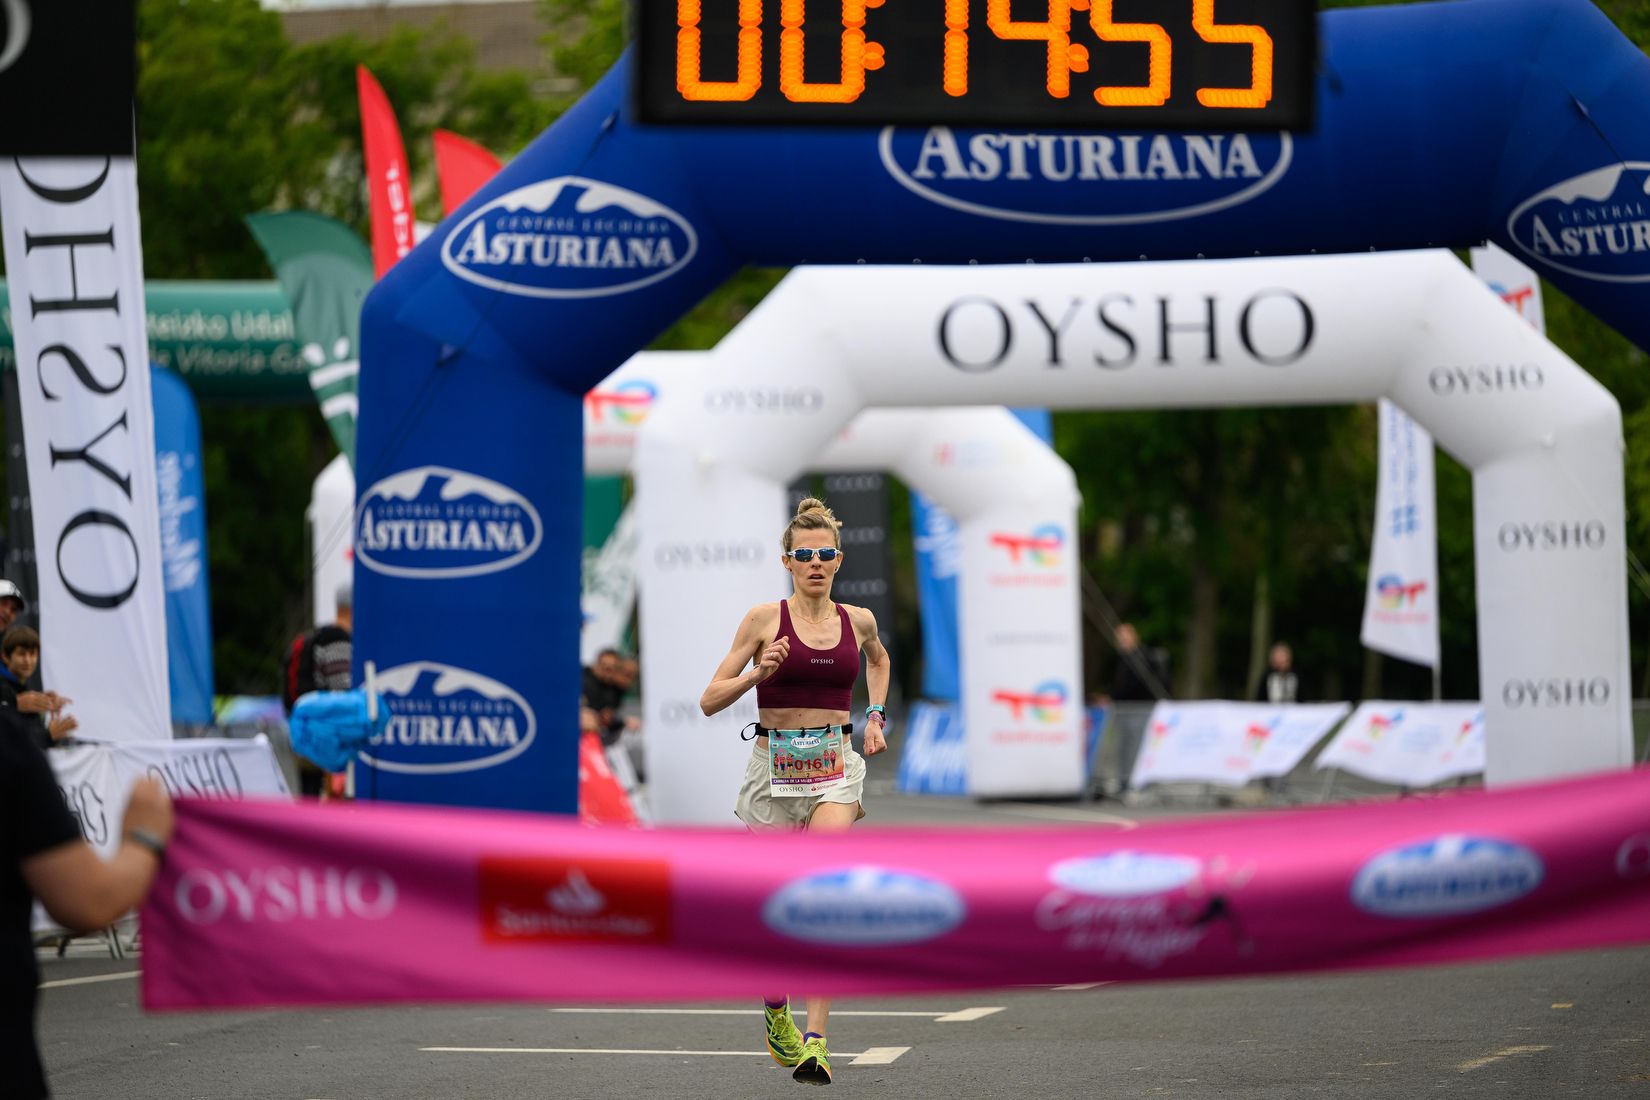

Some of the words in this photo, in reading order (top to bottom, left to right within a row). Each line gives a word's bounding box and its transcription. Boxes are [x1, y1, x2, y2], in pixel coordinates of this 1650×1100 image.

[913, 125, 1262, 181] ASTURIANA
[457, 220, 677, 268] ASTURIANA
[936, 286, 1317, 374] OYSHO
[1429, 364, 1544, 396] OYSHO
[360, 506, 527, 551] ASTURIANA
[1499, 520, 1605, 551] OYSHO
[1503, 678, 1610, 709] OYSHO
[176, 866, 398, 926] OYSHO
